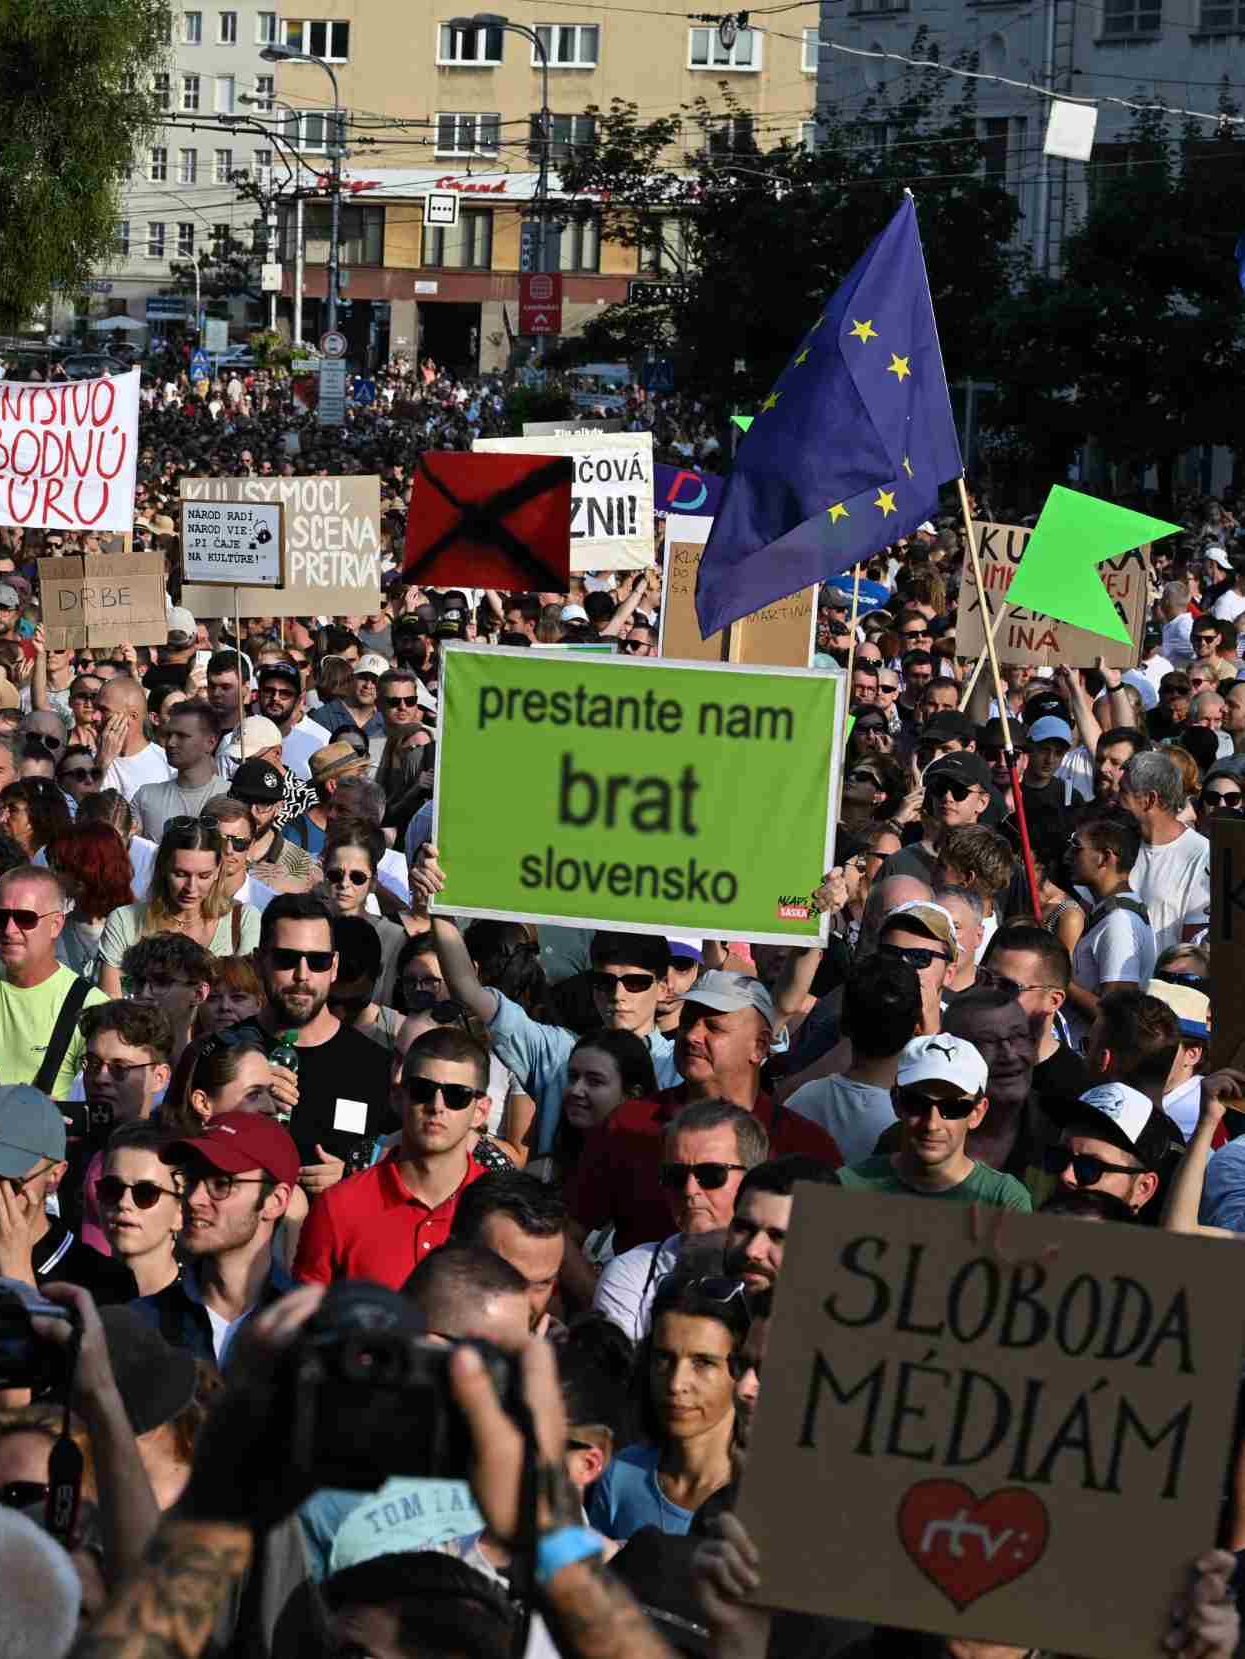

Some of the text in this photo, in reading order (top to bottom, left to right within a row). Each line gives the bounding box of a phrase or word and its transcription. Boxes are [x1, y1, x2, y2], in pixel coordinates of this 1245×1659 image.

[187, 552, 202, 562] NA
[478, 685, 794, 742] prestante nam
[557, 752, 702, 837] brat
[519, 846, 739, 905] slovensko
[823, 1235, 1196, 1375] SLOBODA
[796, 1348, 1194, 1500] MÉDIÁM
